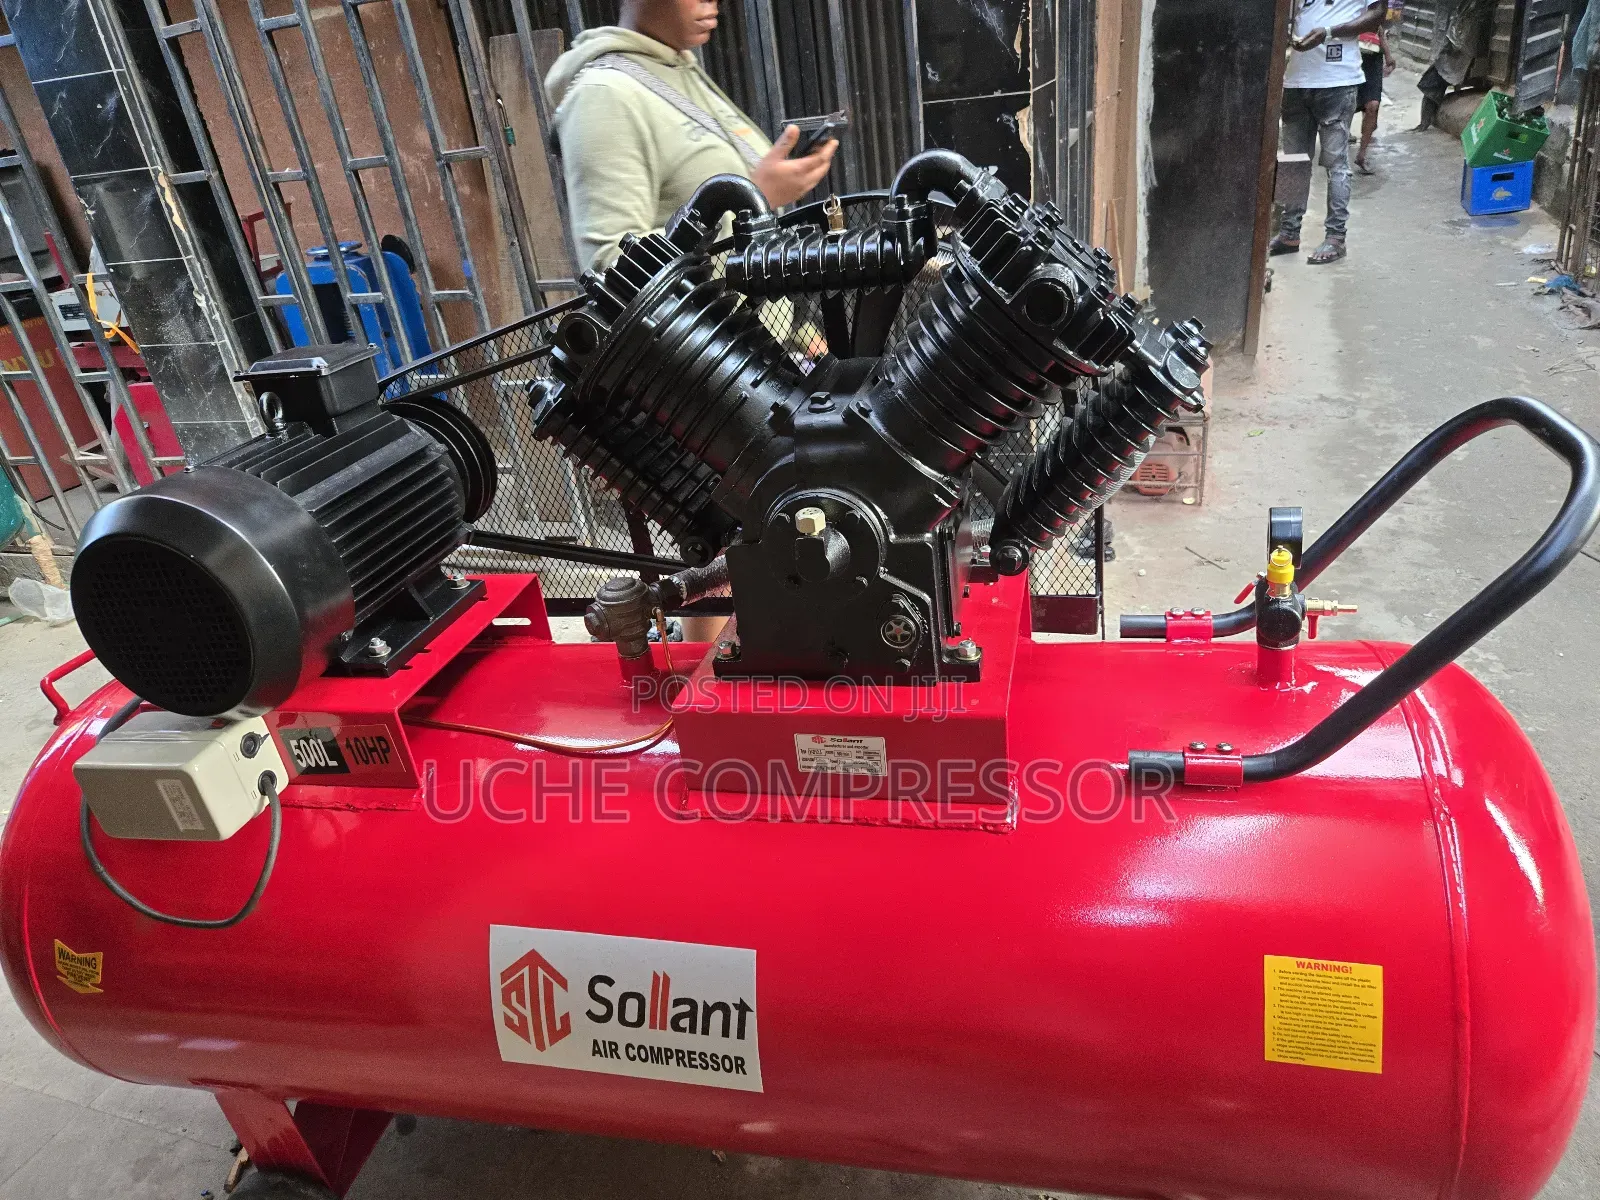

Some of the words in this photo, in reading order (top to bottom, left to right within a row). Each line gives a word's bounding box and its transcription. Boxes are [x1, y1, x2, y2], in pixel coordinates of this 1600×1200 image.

[290, 739, 338, 768] 500L
[345, 736, 391, 765] 10HP
[58, 947, 97, 970] WARNING
[1295, 961, 1353, 974] WARNING!
[585, 970, 754, 1040] Sollant
[591, 1039, 621, 1060] AIR
[625, 1043, 747, 1075] COMPRESSOR
